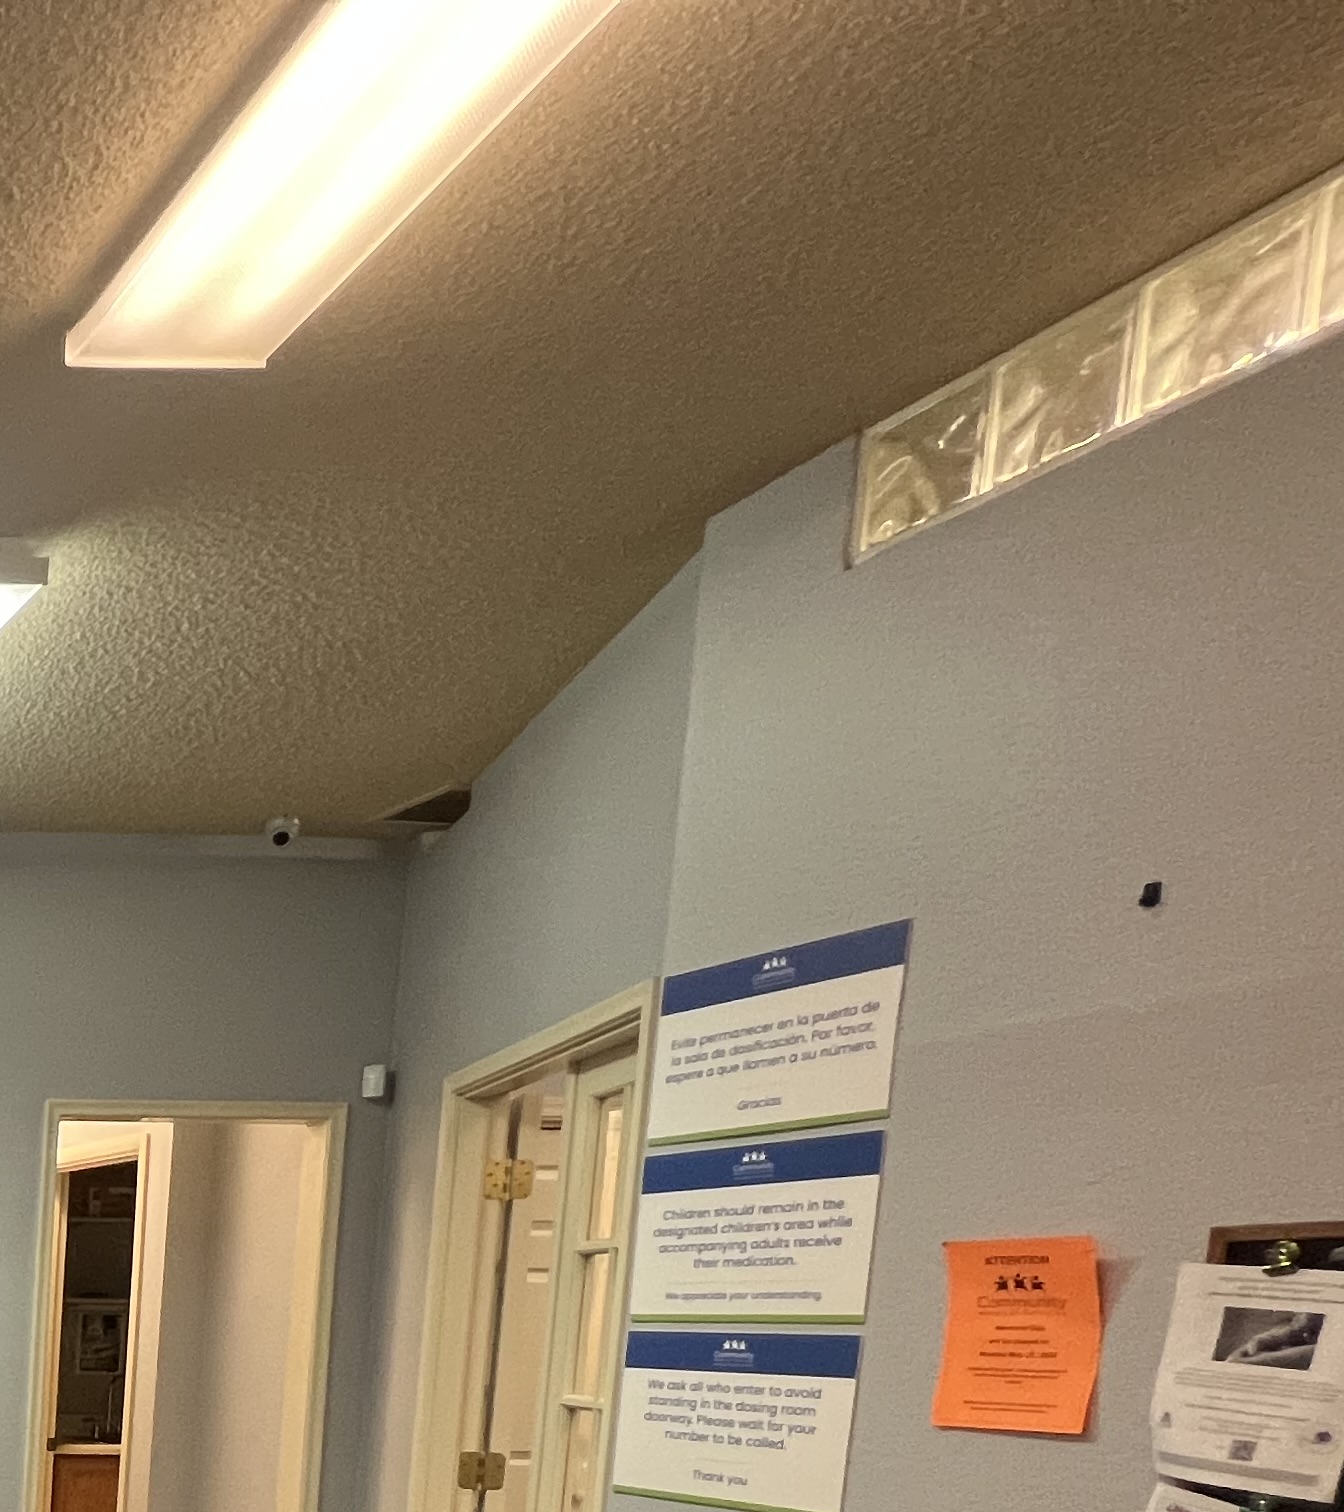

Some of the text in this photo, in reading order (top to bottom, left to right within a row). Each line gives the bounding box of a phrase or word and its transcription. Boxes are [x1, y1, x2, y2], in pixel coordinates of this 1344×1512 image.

[777, 1018, 794, 1030] en
[797, 1014, 809, 1025] la
[812, 1006, 858, 1027] puerta
[861, 1000, 880, 1014] de
[671, 1054, 682, 1066] la
[685, 1051, 709, 1064] sala
[711, 1047, 726, 1059] de
[811, 1028, 833, 1043] Por
[705, 1066, 716, 1077] a
[717, 1062, 740, 1077] que
[789, 1052, 798, 1063] a
[801, 1050, 818, 1061] su
[663, 1198, 846, 1221] Children should remain in the
[653, 1215, 853, 1240] designated children's area while
[658, 1234, 843, 1255] accompanying adults receive
[693, 1255, 797, 1270] their medication.
[647, 1377, 823, 1400] We ask all who enter to avoid
[648, 1394, 817, 1418] standing in the dosing room
[643, 1410, 817, 1437] doorway. Please wait for your
[664, 1429, 787, 1451] number to be called.
[692, 1468, 725, 1484] Thank
